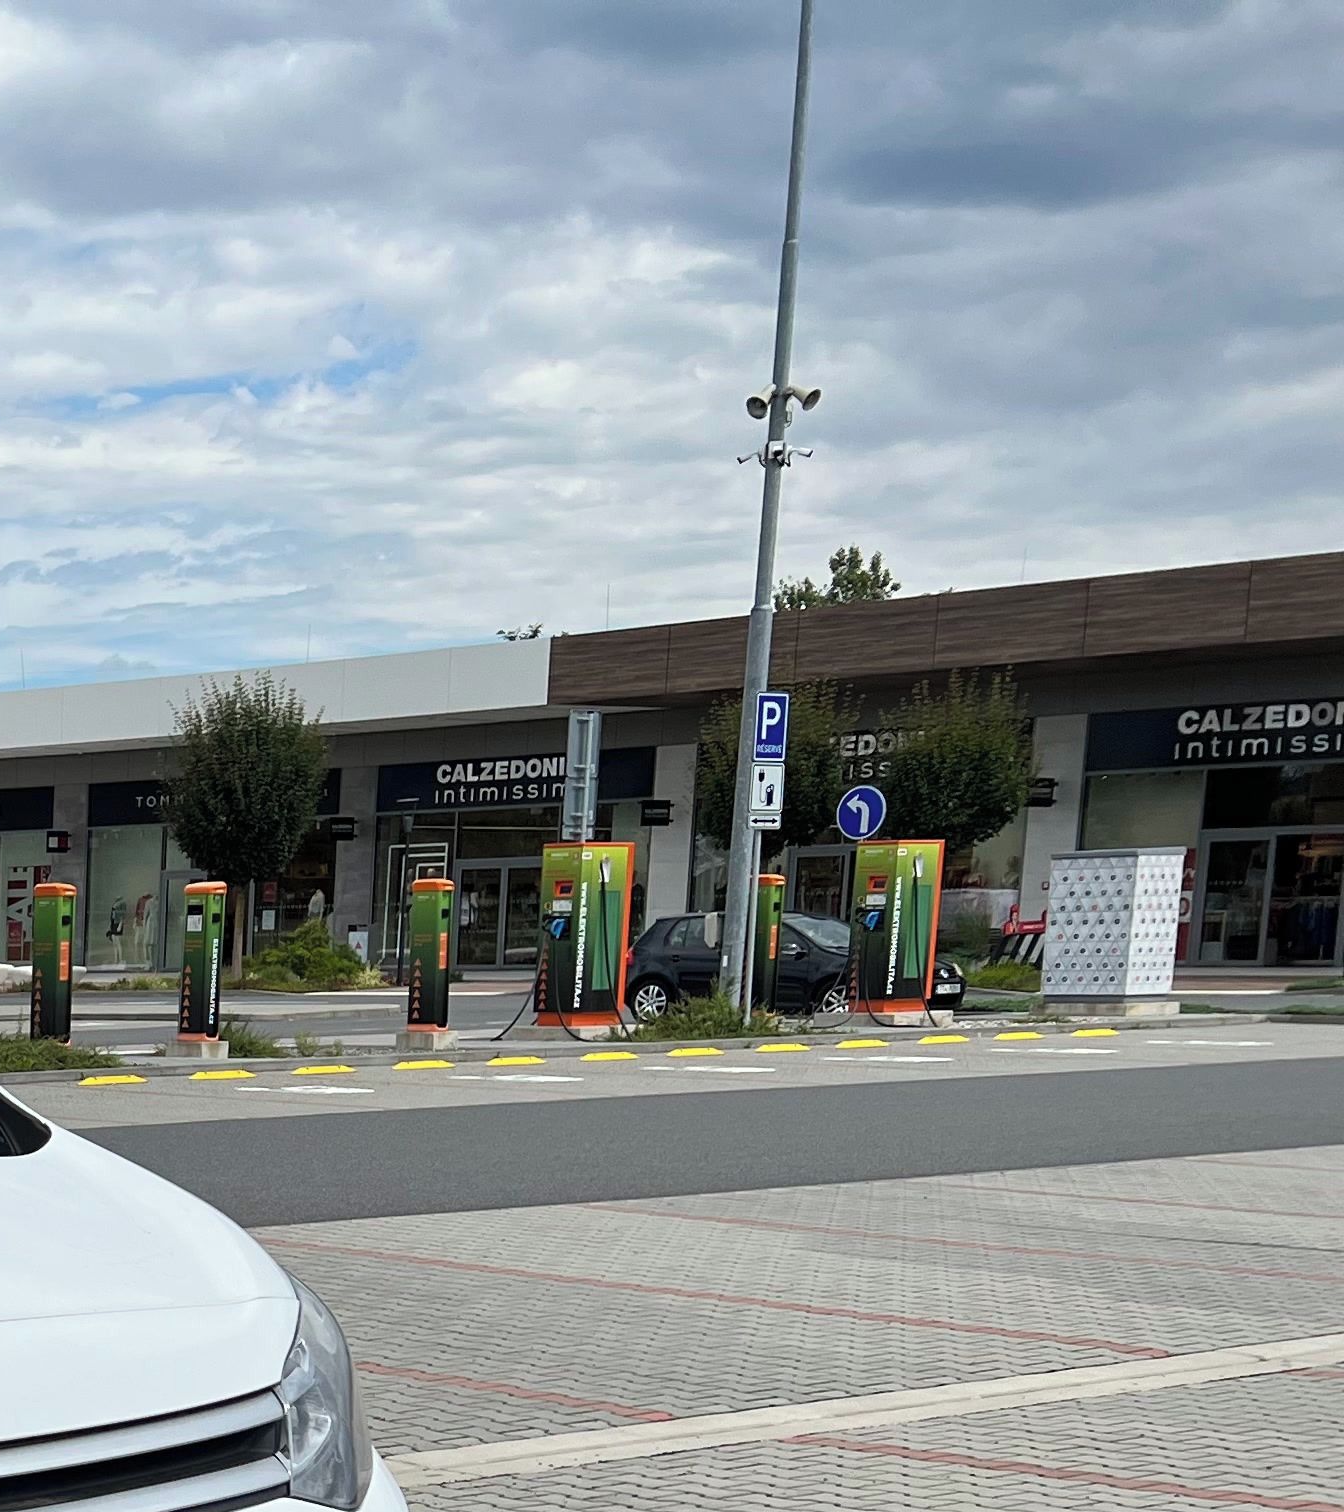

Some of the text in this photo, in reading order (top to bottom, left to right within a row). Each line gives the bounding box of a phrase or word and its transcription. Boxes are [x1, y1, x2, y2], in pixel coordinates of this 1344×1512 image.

[761, 701, 781, 740] P
[436, 757, 566, 784] CALZEDONI
[135, 794, 185, 809] TOMM
[434, 782, 565, 804] intimissim
